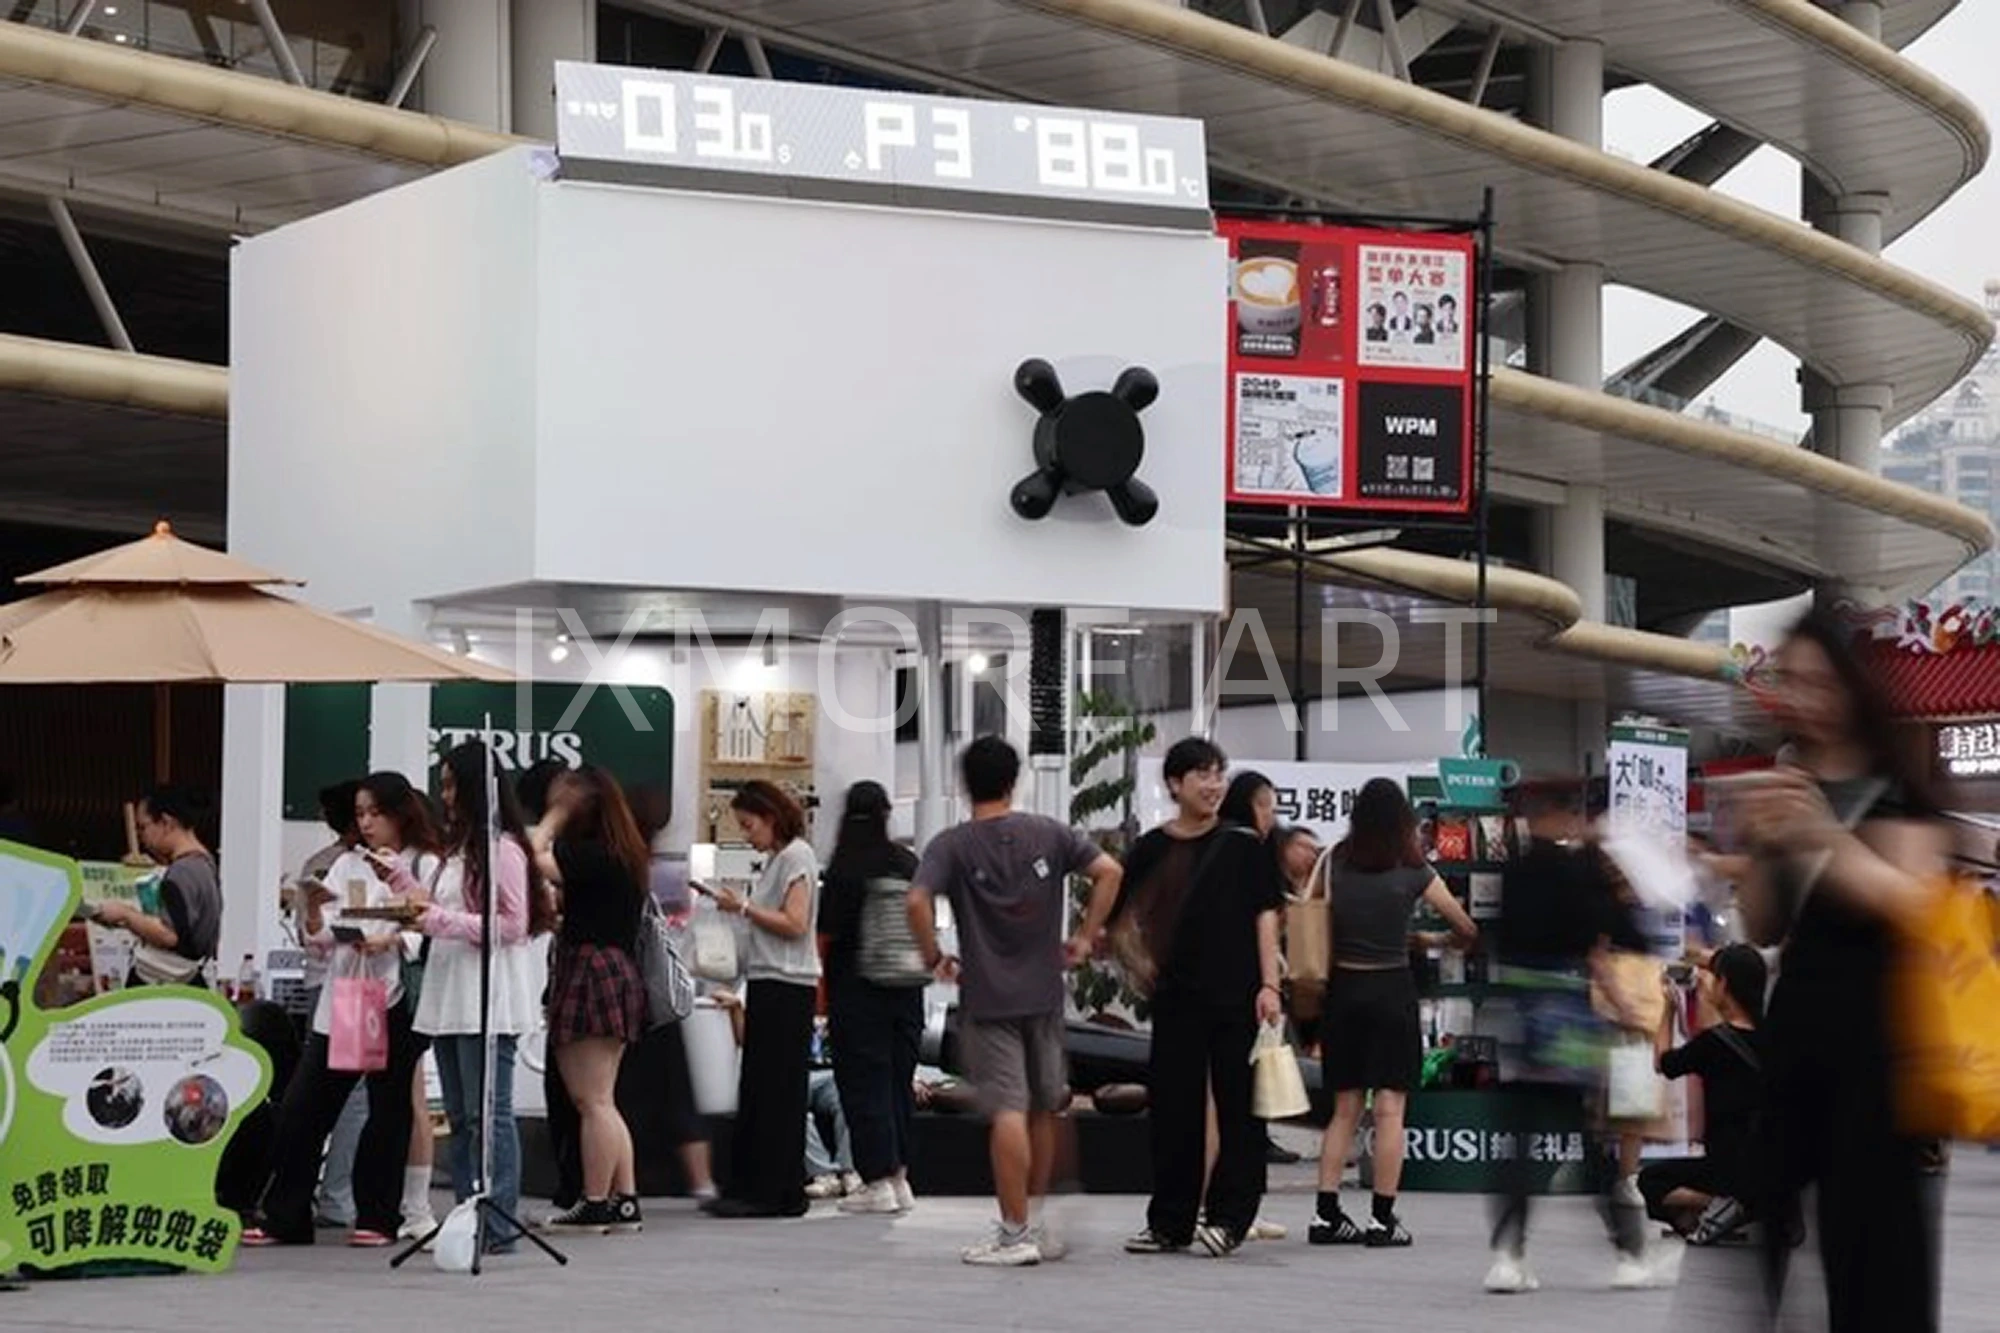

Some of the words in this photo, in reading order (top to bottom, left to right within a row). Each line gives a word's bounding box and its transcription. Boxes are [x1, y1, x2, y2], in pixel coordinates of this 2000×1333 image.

[1384, 415, 1438, 436] WPM
[11, 1163, 110, 1217] 免费领取
[26, 1203, 230, 1262] 可降解兜兜袋
